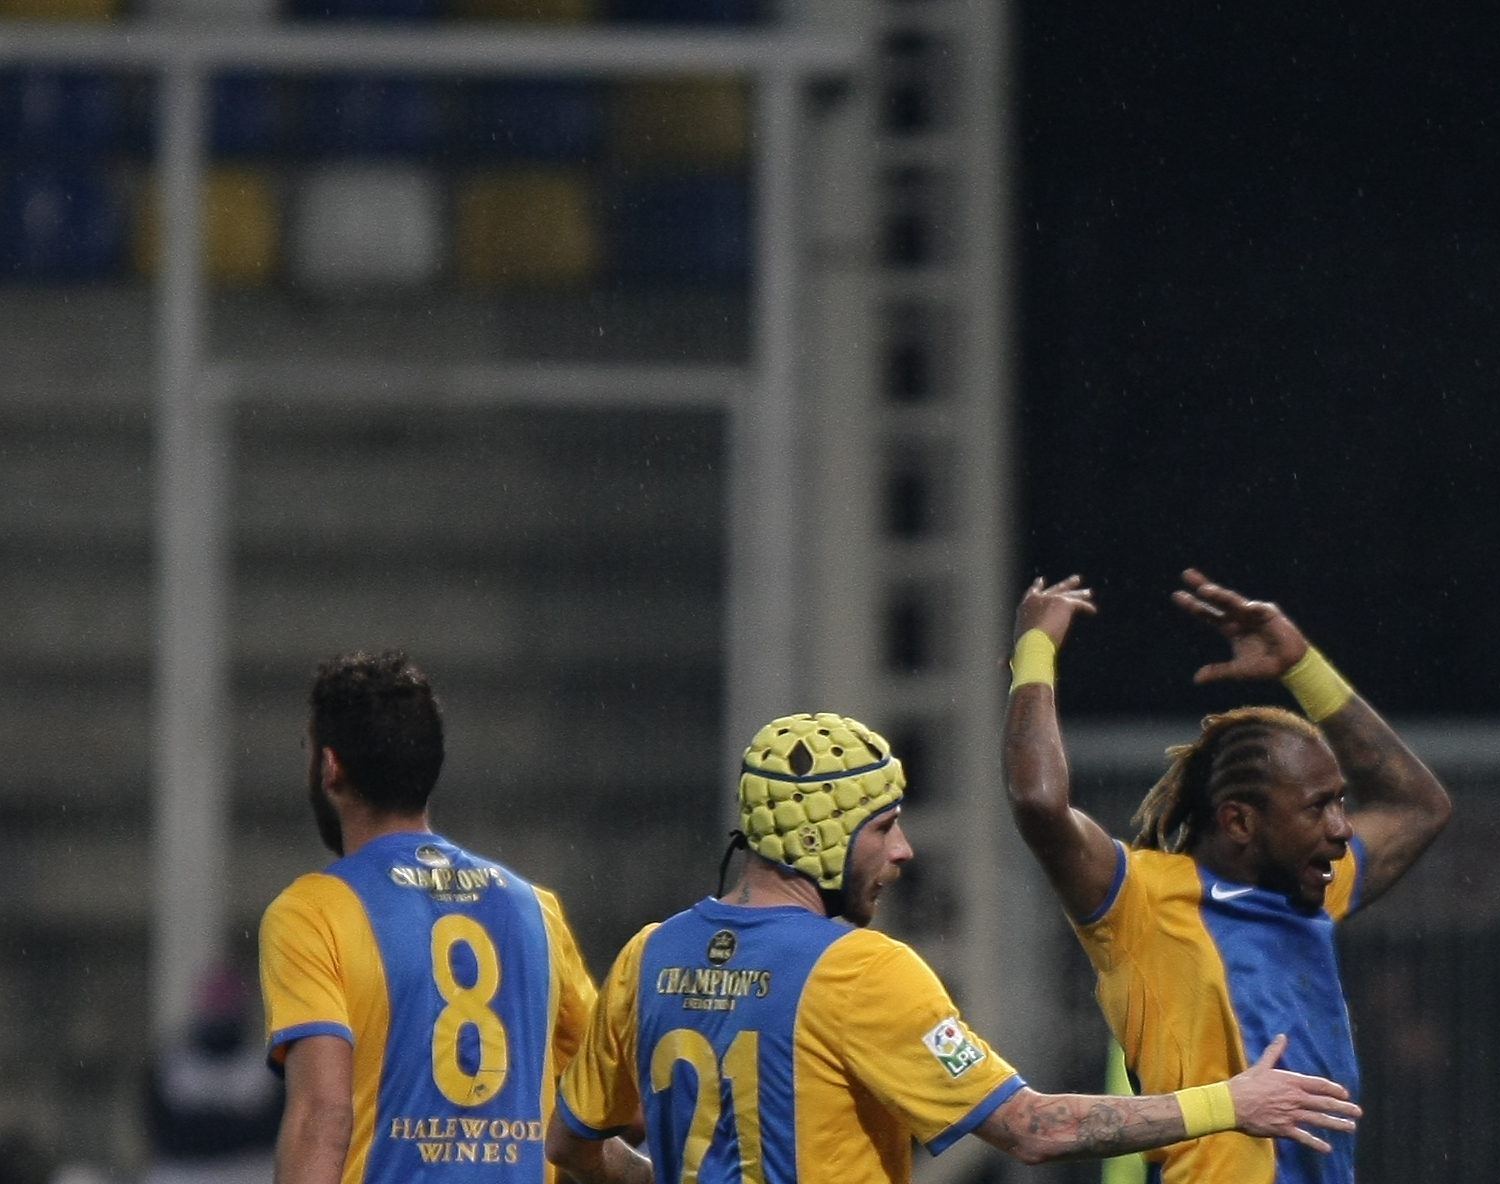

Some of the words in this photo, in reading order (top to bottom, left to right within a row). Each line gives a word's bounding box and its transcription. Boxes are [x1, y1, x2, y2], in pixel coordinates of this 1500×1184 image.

[656, 968, 771, 997] CHAMPION'S
[430, 913, 508, 1107] 8
[389, 1117, 543, 1141] HALEWOOD
[416, 1142, 518, 1164] WINES
